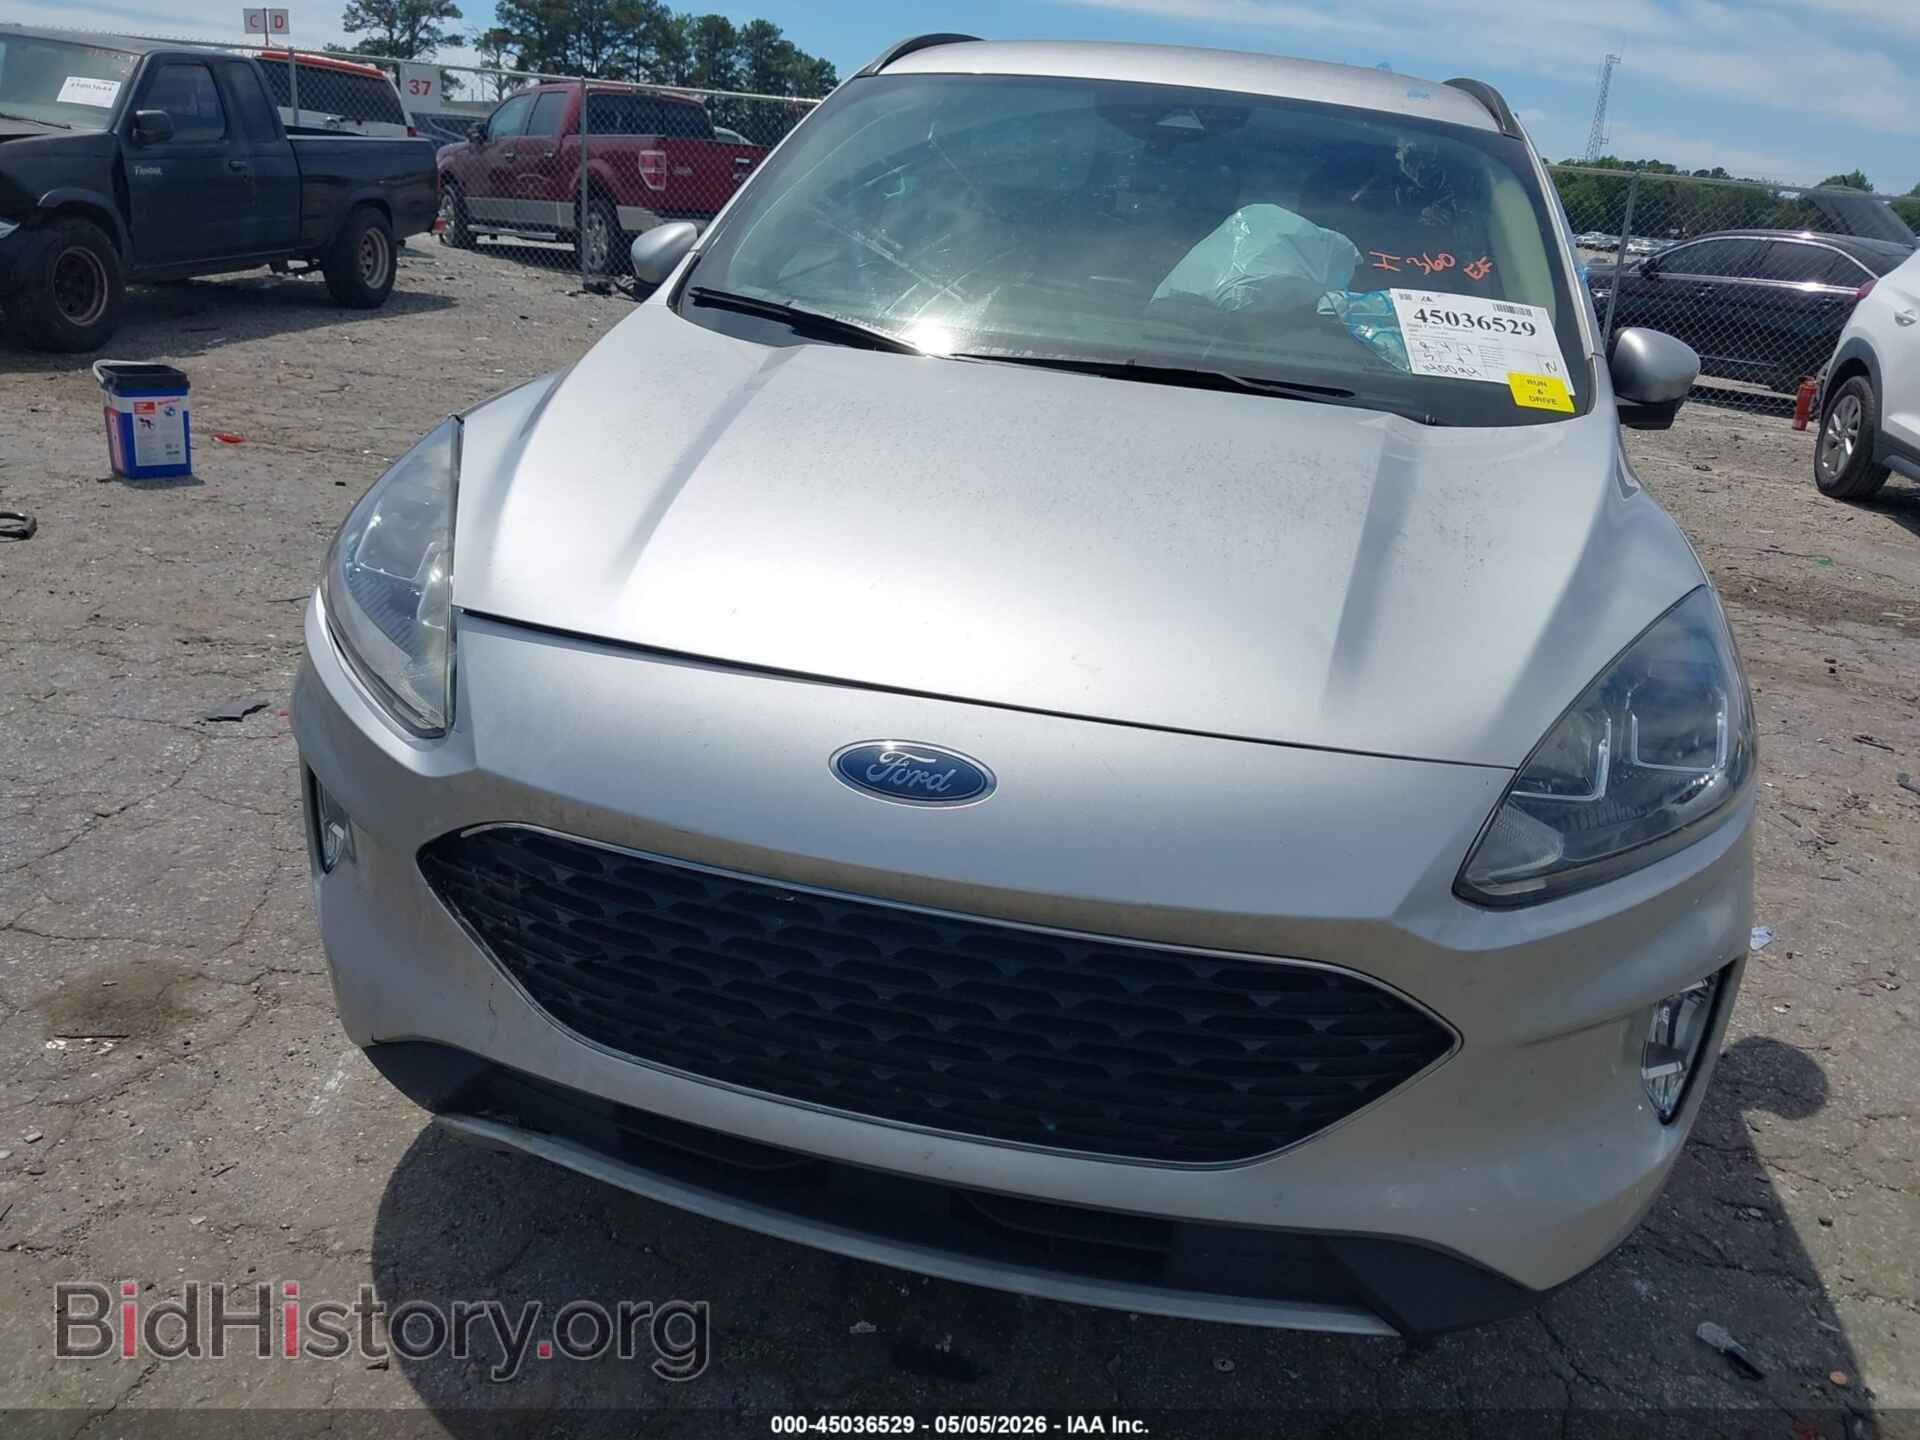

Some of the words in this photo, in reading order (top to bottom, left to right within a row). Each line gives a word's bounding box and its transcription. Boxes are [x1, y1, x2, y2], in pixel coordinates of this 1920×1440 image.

[249, 15, 259, 28] C
[274, 15, 285, 29] D
[408, 79, 431, 96] 37
[1413, 308, 1536, 337] 45036529
[865, 750, 957, 793] Ford
